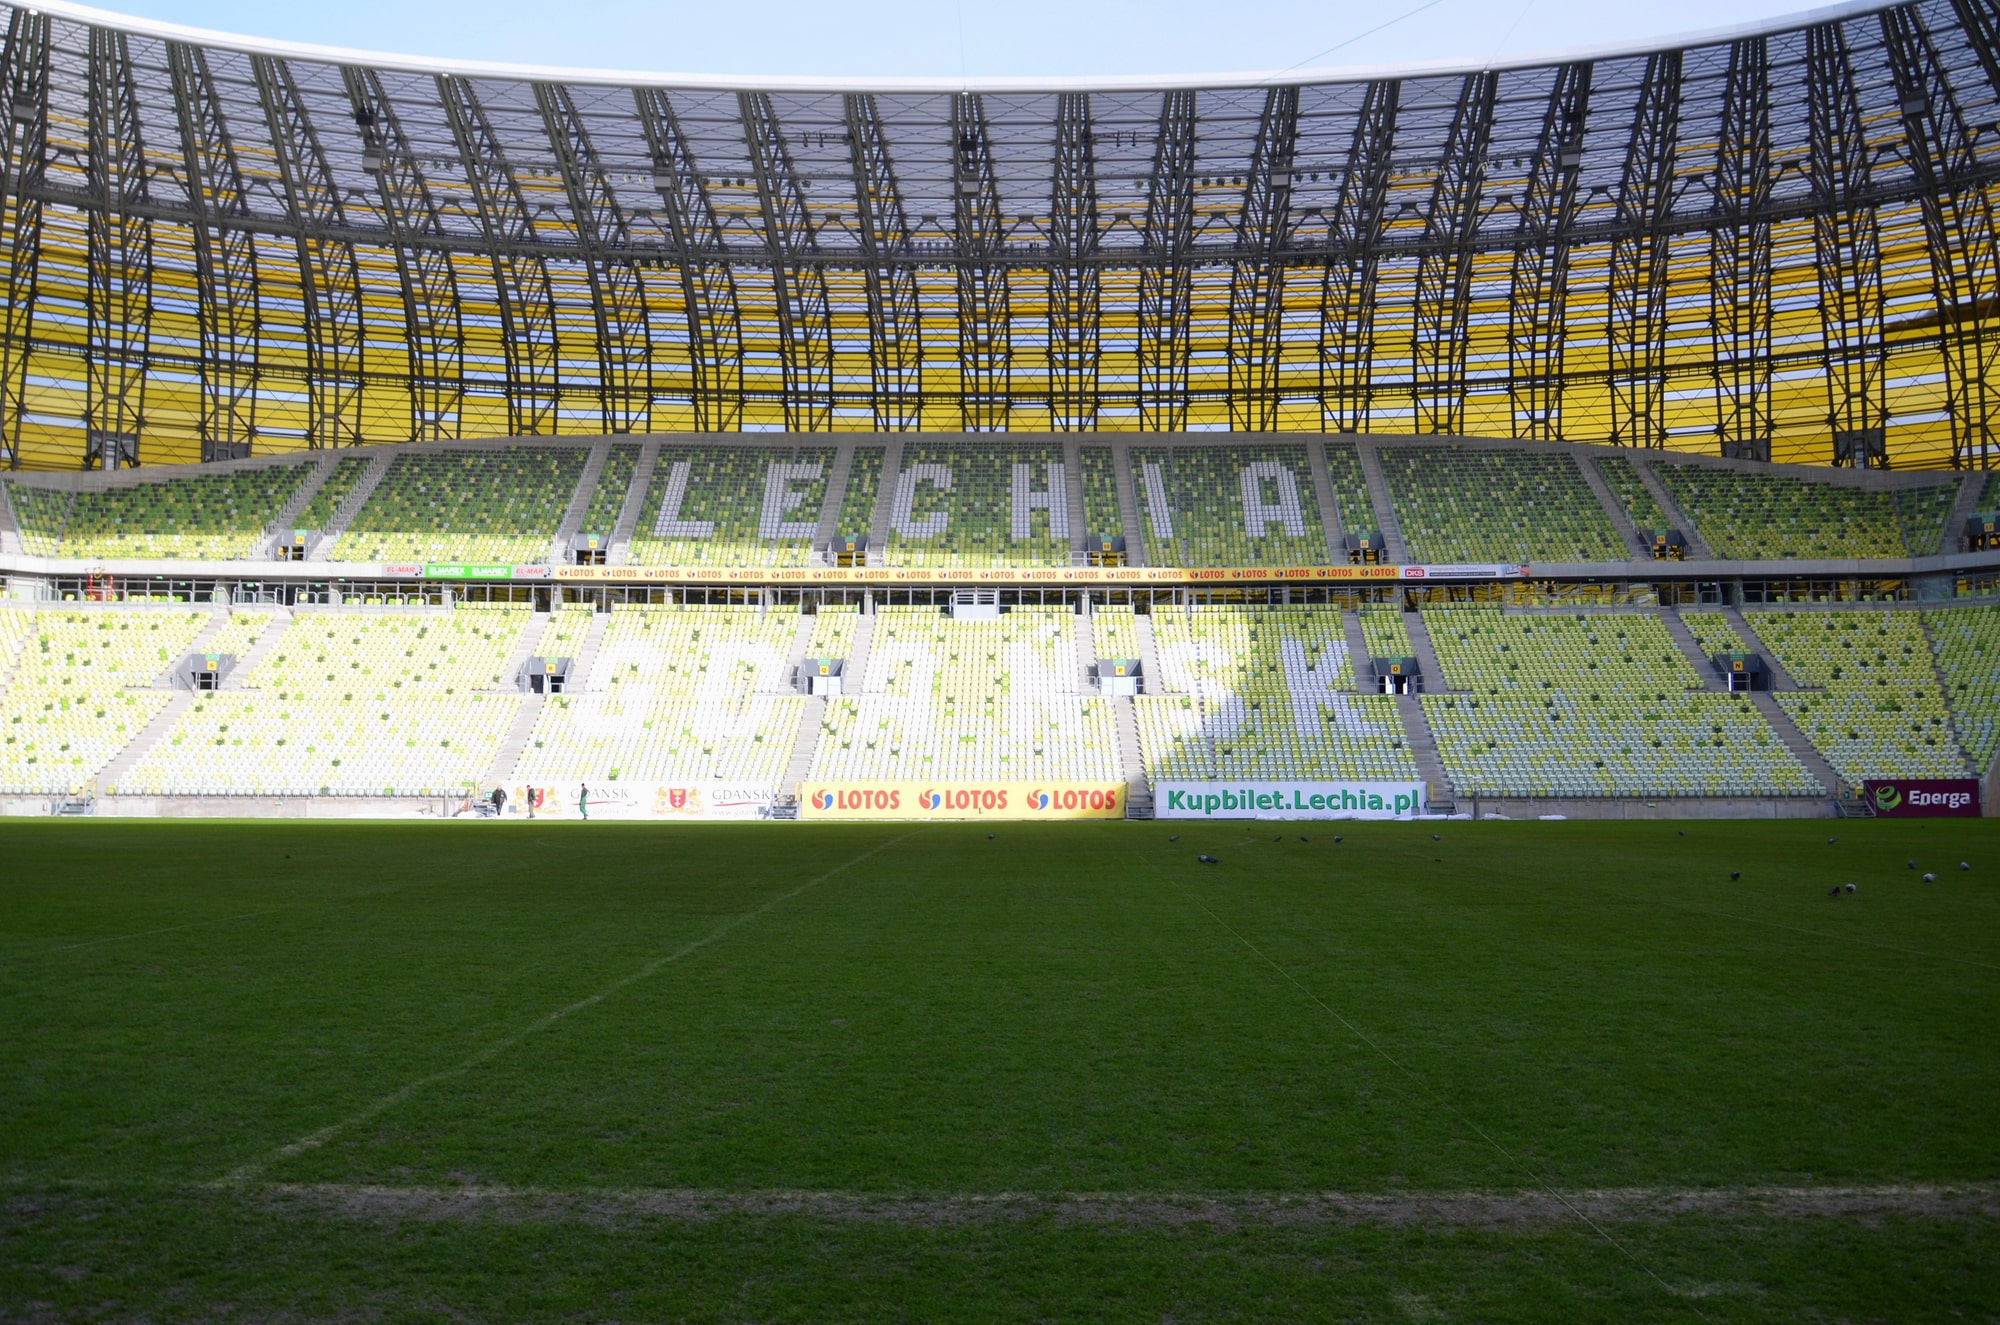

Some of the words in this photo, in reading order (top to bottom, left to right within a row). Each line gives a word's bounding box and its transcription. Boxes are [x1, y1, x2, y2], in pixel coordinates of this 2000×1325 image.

[653, 461, 1300, 538] LECHIA
[429, 567, 465, 575] ELMAREX
[471, 567, 508, 575] ELMAREX
[516, 567, 544, 575] EL-MAR
[570, 569, 594, 577] LOTOS
[655, 570, 679, 578] LOTOS
[740, 571, 763, 579] LOTOS
[782, 571, 805, 579] LOTOS
[824, 571, 847, 579] LOTOS
[865, 571, 889, 579] LOTOS
[907, 571, 930, 579] LOTOS
[949, 571, 972, 579] LOTOS
[990, 571, 1014, 579] LOTOS
[1032, 571, 1056, 579] LOTOS
[1074, 571, 1098, 579] LOTOS
[1116, 571, 1140, 579] LOTOS
[1158, 571, 1182, 579] LOTOS
[1200, 570, 1226, 579] LOTOS
[1242, 570, 1268, 578] LOTOS
[1285, 569, 1310, 578] LOTOS
[1327, 569, 1353, 577] LOTOS
[1370, 568, 1396, 577] LOTOS
[838, 789, 900, 810] LOTOS
[946, 789, 1007, 810] LOTOS
[1053, 789, 1116, 810] LOTOS
[1168, 789, 1419, 815] Kupbilet.Lechia.pl
[1909, 790, 1970, 809] Energa
